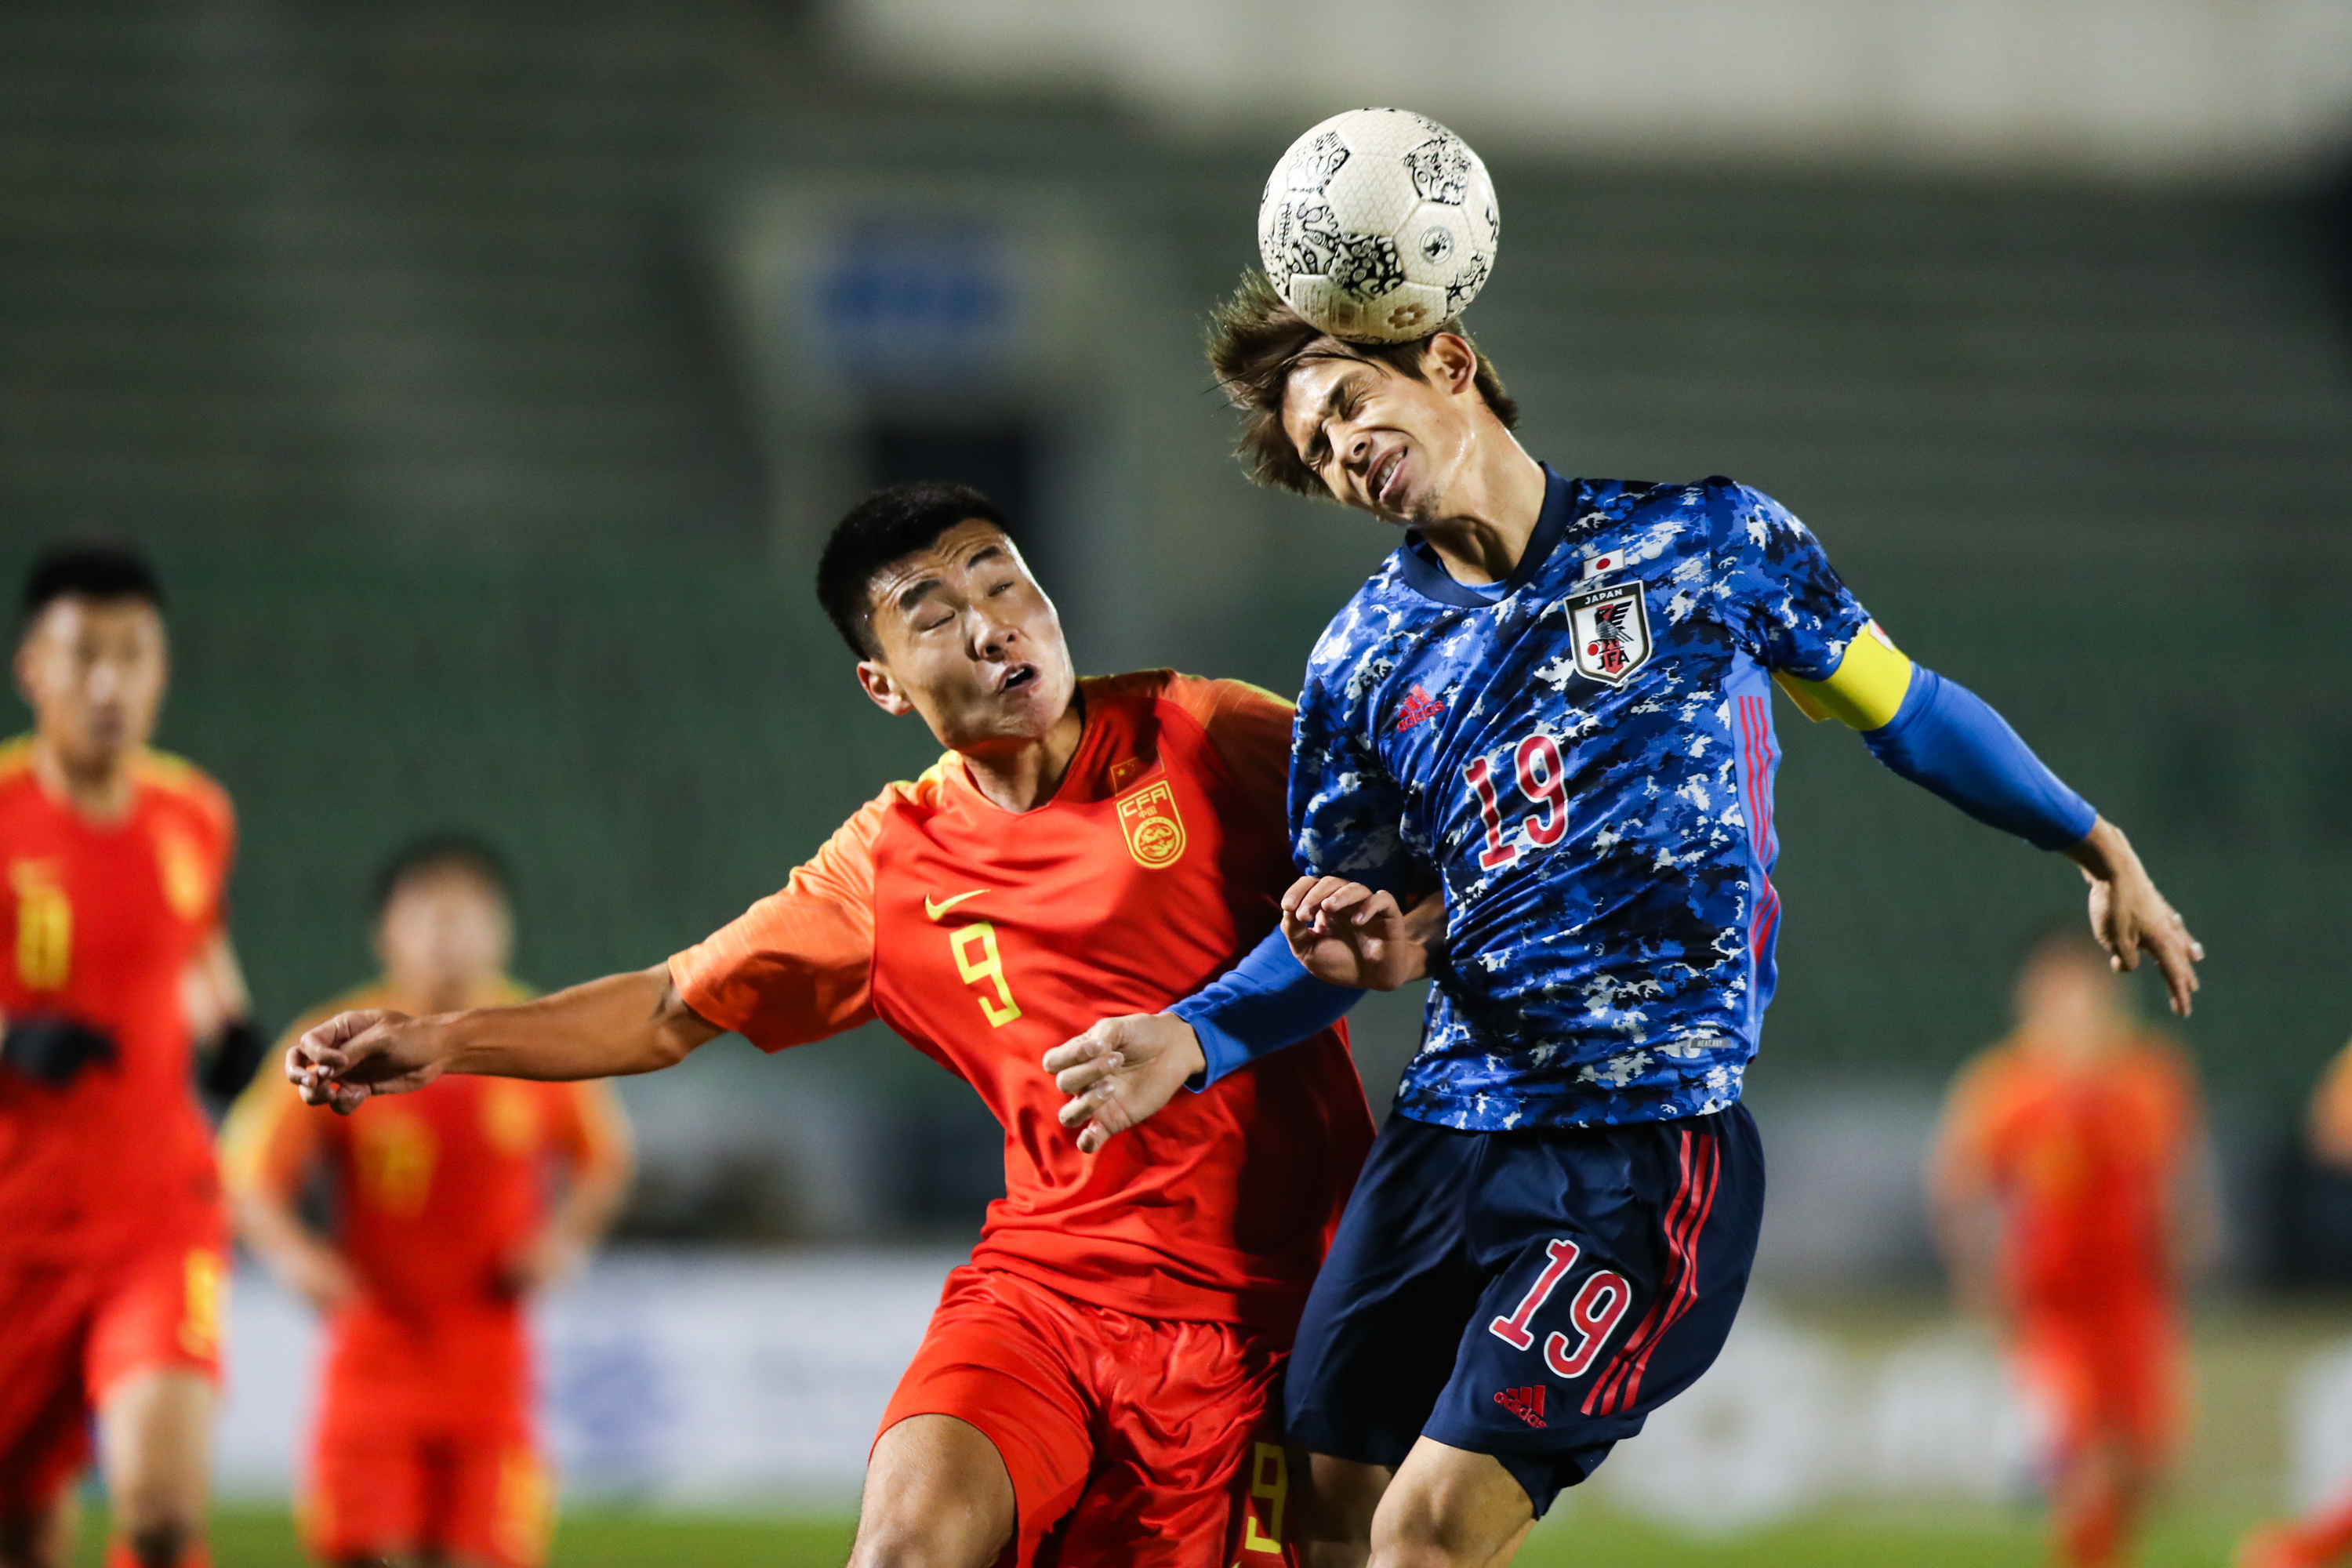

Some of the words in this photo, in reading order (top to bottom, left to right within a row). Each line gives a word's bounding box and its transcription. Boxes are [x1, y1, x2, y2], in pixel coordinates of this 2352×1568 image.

[1584, 589, 1623, 605] JAPAN
[1597, 650, 1631, 670] JFA
[1396, 700, 1445, 732] adidas
[1121, 786, 1167, 818] CFA
[1462, 732, 1570, 872] 19
[949, 920, 1022, 1029] 9
[1489, 1239, 1632, 1379] 19
[1494, 1392, 1548, 1428] adidas
[1244, 1442, 1288, 1555] 9
